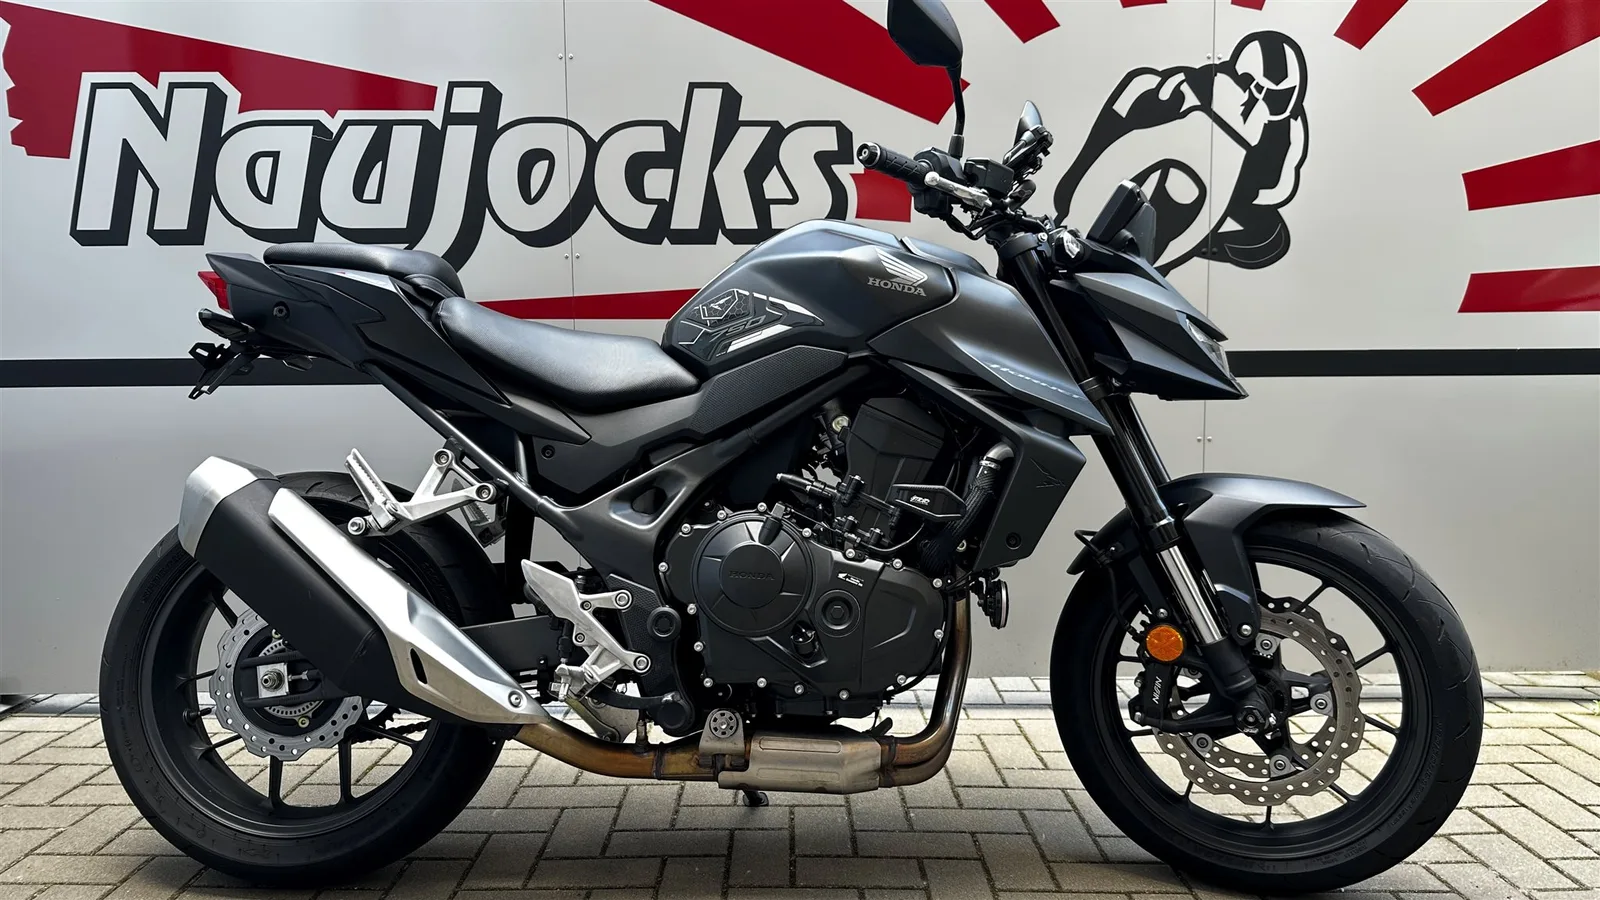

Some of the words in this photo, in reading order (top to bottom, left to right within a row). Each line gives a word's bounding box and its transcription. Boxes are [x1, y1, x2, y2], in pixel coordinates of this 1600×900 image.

[70, 81, 856, 271] Naujocks
[867, 276, 927, 297] HONDA
[728, 568, 776, 582] HONDA
